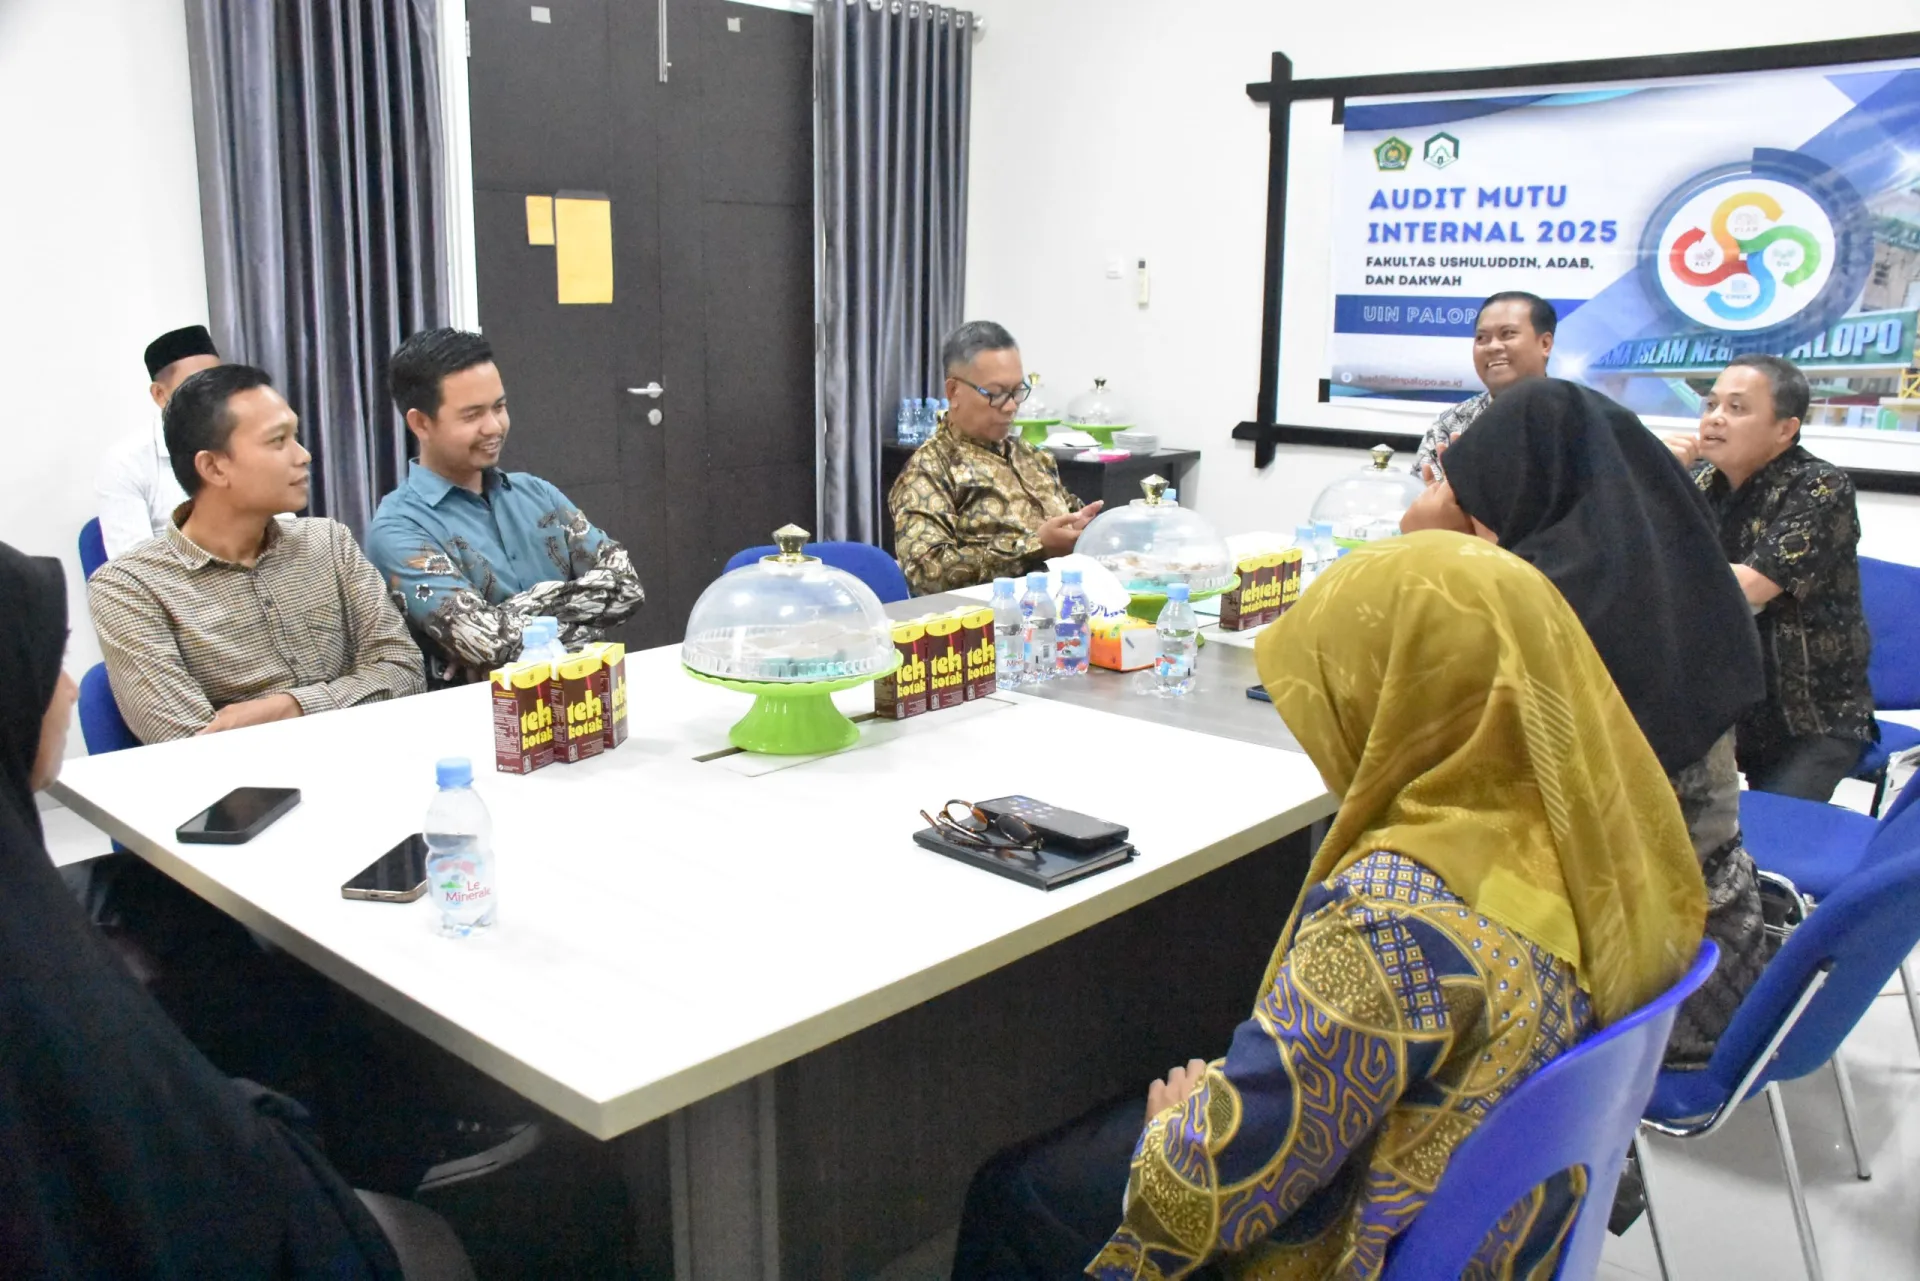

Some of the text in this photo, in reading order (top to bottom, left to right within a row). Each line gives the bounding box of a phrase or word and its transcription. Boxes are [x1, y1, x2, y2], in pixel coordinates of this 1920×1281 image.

[1369, 185, 1567, 210] AUDIT MUTU
[1367, 220, 1618, 243] INTERNAL 2025
[1366, 256, 1594, 270] FAKULTAS USHULUDDIN, ADAB,
[1365, 275, 1462, 286] DAN DAKWAH
[1363, 306, 1478, 324] UIN PALOP
[1778, 318, 1901, 359] ALOPO
[931, 646, 962, 676] teh
[967, 637, 994, 667] teh
[896, 654, 926, 684] teh
[931, 671, 962, 690] kotak
[967, 662, 995, 681] kotak
[897, 679, 926, 698] kotak
[521, 698, 553, 734] teh
[567, 690, 602, 724] teh
[522, 727, 553, 750] kotak
[568, 717, 603, 740] kotak
[446, 886, 491, 902] Minerale
[467, 880, 480, 891] Le
